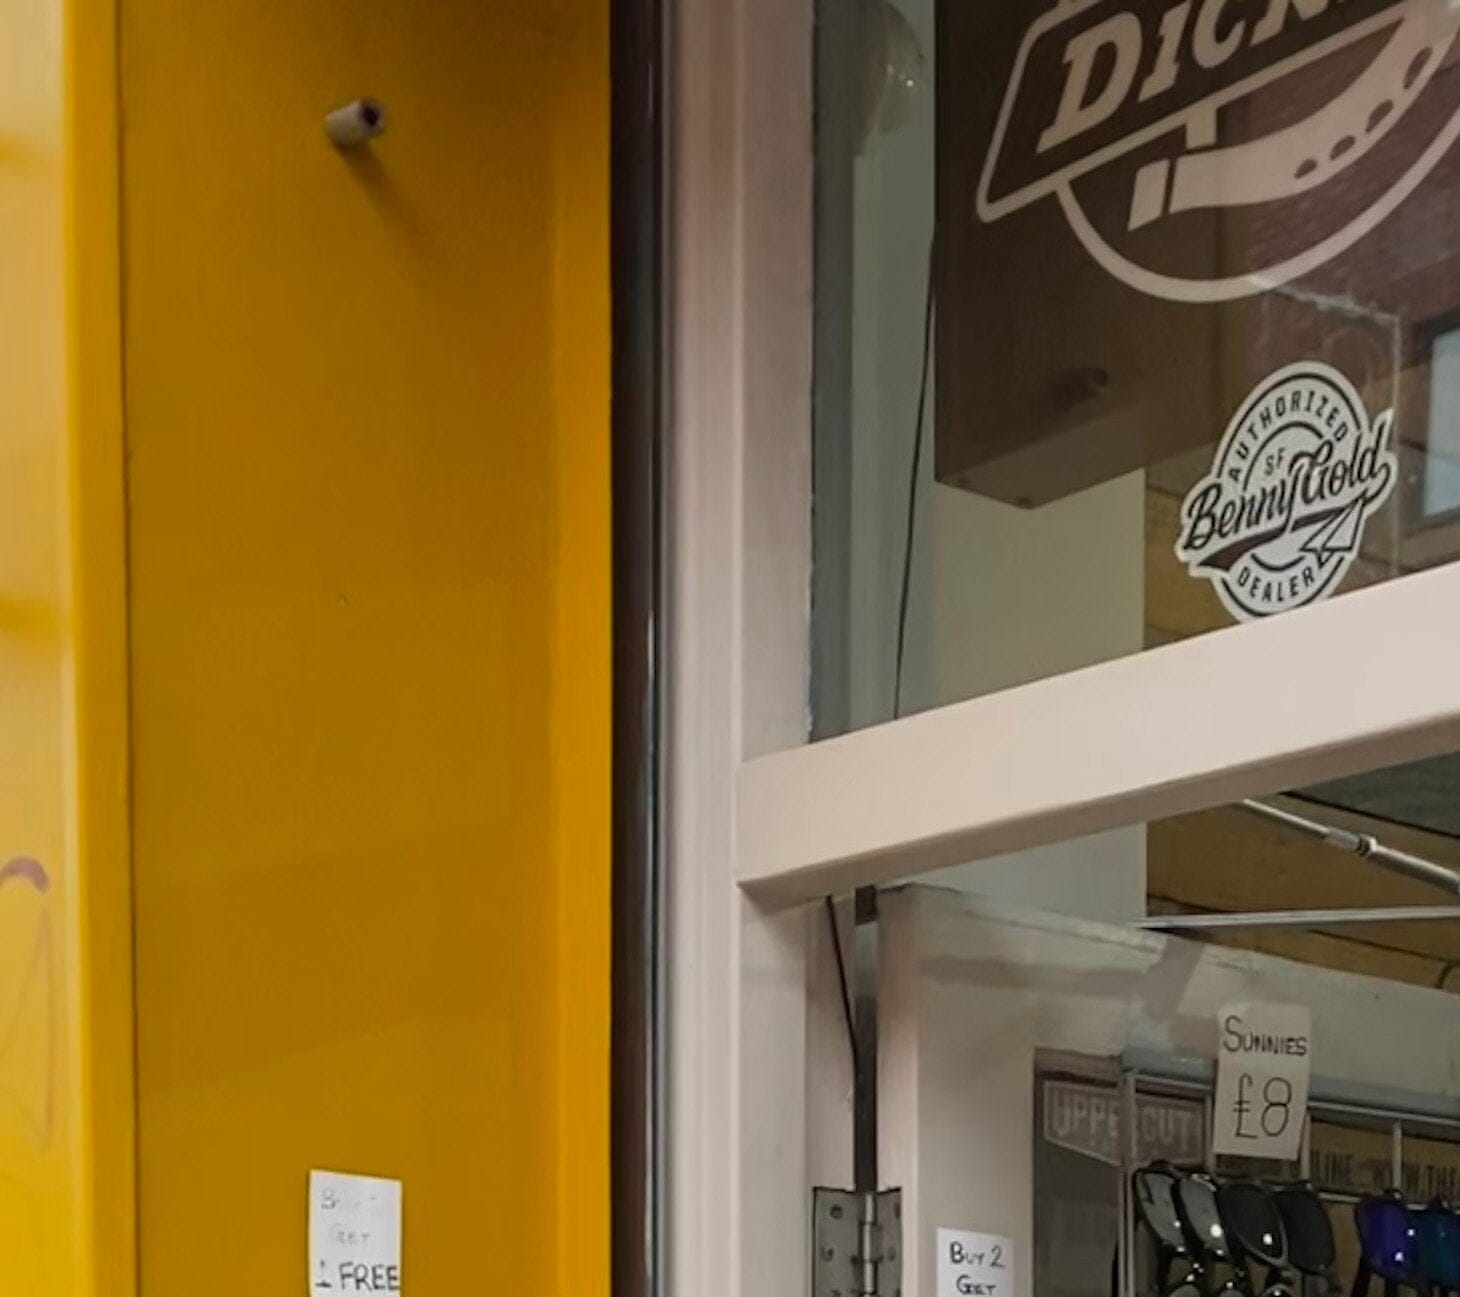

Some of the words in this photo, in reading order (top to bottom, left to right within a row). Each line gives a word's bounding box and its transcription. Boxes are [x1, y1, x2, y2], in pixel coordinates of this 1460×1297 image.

[1228, 390, 1349, 482] AUTHORIZED
[1265, 446, 1286, 476] SF
[1236, 566, 1315, 601] DEALER
[1232, 1073, 1292, 1139] £8
[990, 1244, 1006, 1269] 2
[338, 1261, 402, 1292] FREE
